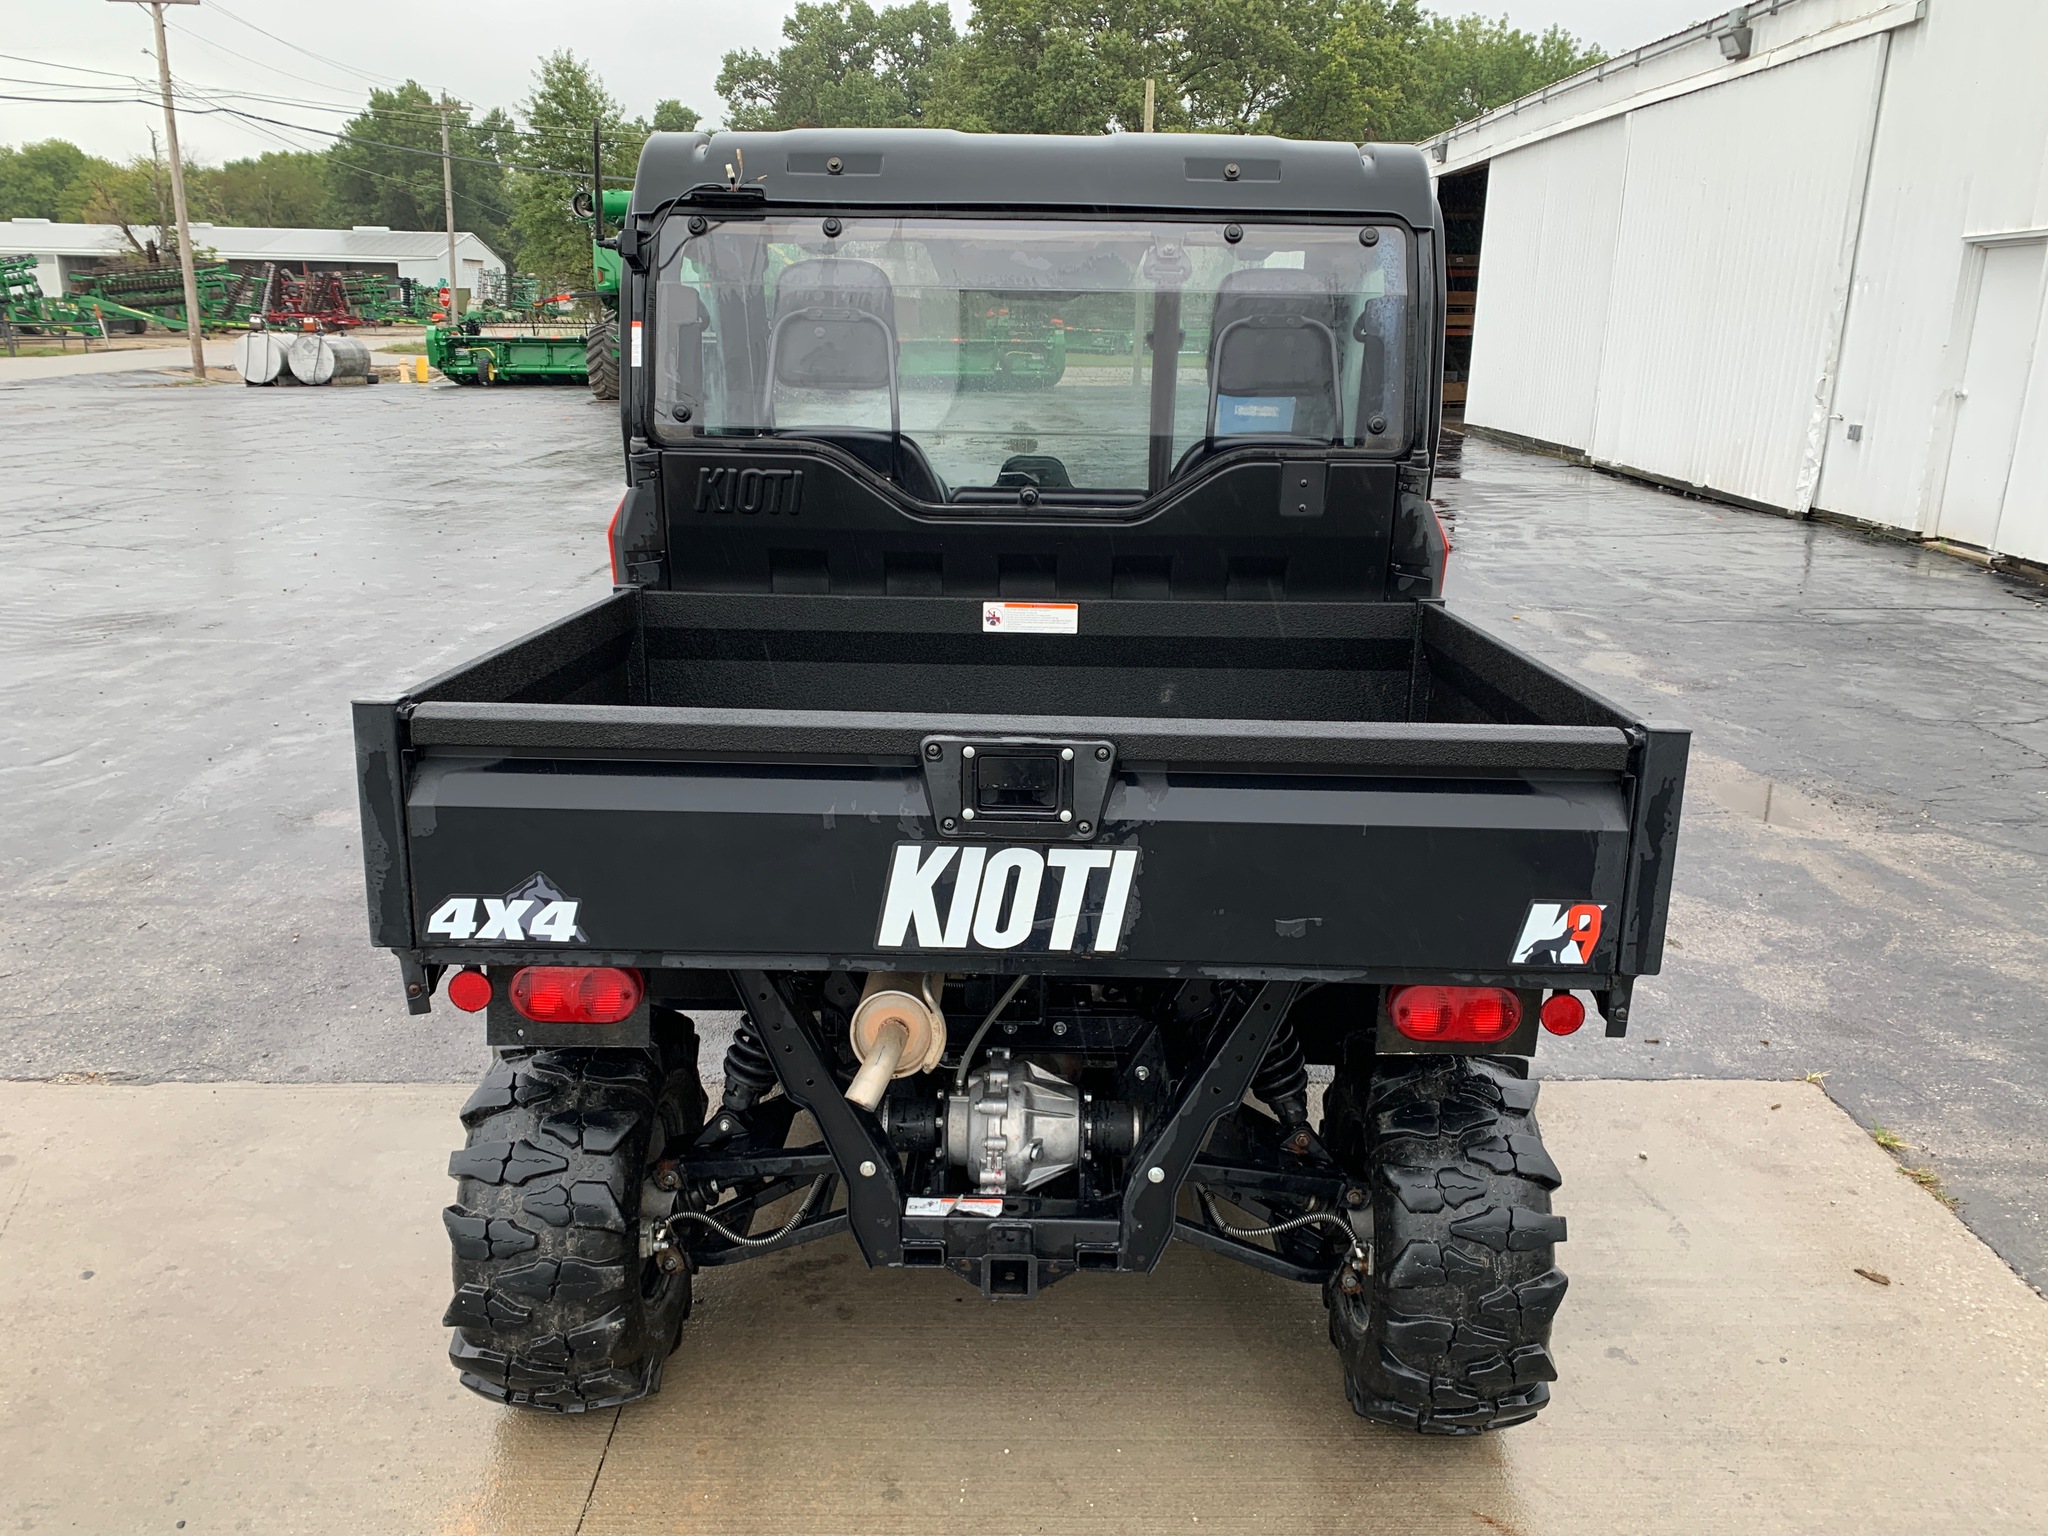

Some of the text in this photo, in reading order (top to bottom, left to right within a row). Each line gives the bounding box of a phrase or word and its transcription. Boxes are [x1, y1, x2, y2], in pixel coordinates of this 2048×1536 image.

[694, 467, 803, 514] KIOTI
[877, 845, 1138, 951] KIOTI
[1511, 903, 1608, 964] K9
